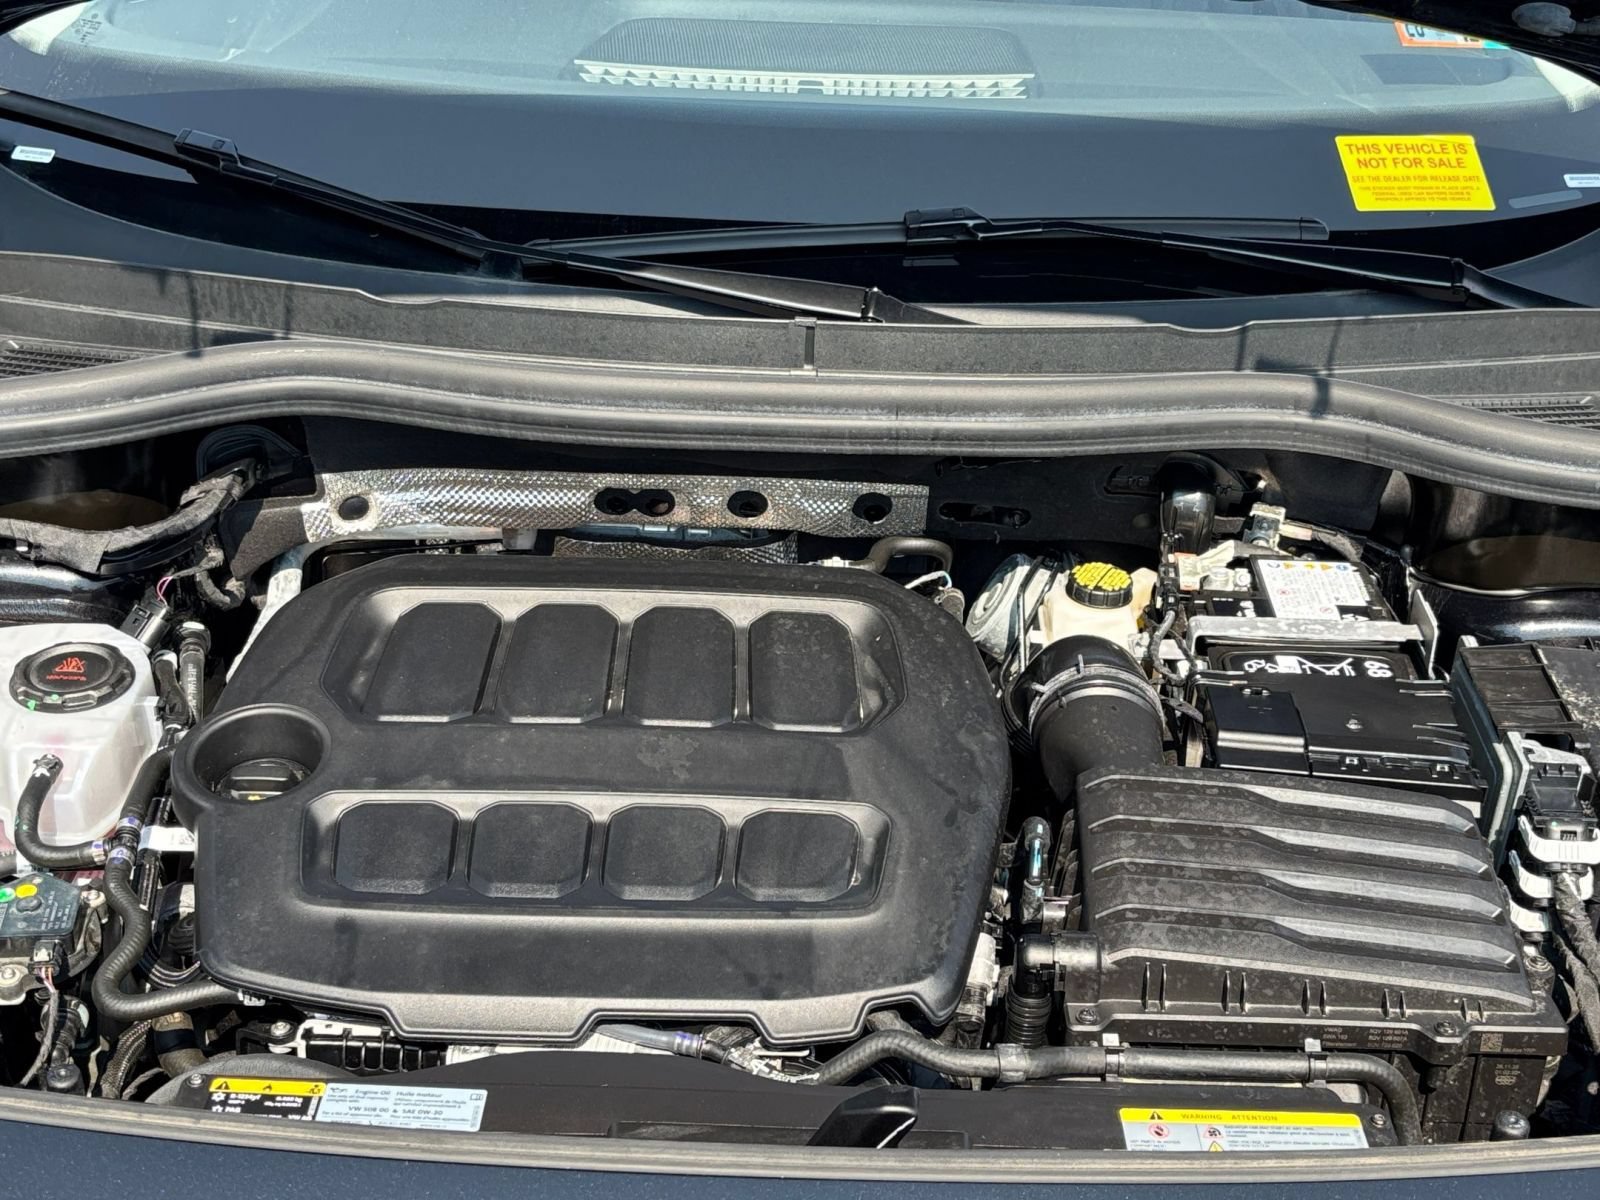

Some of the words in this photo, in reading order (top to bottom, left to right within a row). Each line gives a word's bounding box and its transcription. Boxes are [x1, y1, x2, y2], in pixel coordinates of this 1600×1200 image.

[1344, 143, 1382, 155] THIS
[1384, 143, 1450, 155] VEHICLE
[1453, 143, 1468, 155] IS
[1357, 157, 1388, 169] NOT
[1392, 157, 1424, 169] FOR
[1428, 157, 1467, 169] SALE
[1351, 175, 1365, 183] SEE
[1368, 175, 1381, 183] THE
[1383, 175, 1410, 183] DEALER
[1413, 175, 1428, 183] FOR
[1430, 175, 1460, 183] RELEASE
[1463, 175, 1481, 183] DATE
[354, 1088, 379, 1096] Engine
[1181, 1113, 1223, 1121] WARNING
[1231, 1114, 1278, 1122] ATTENTION
